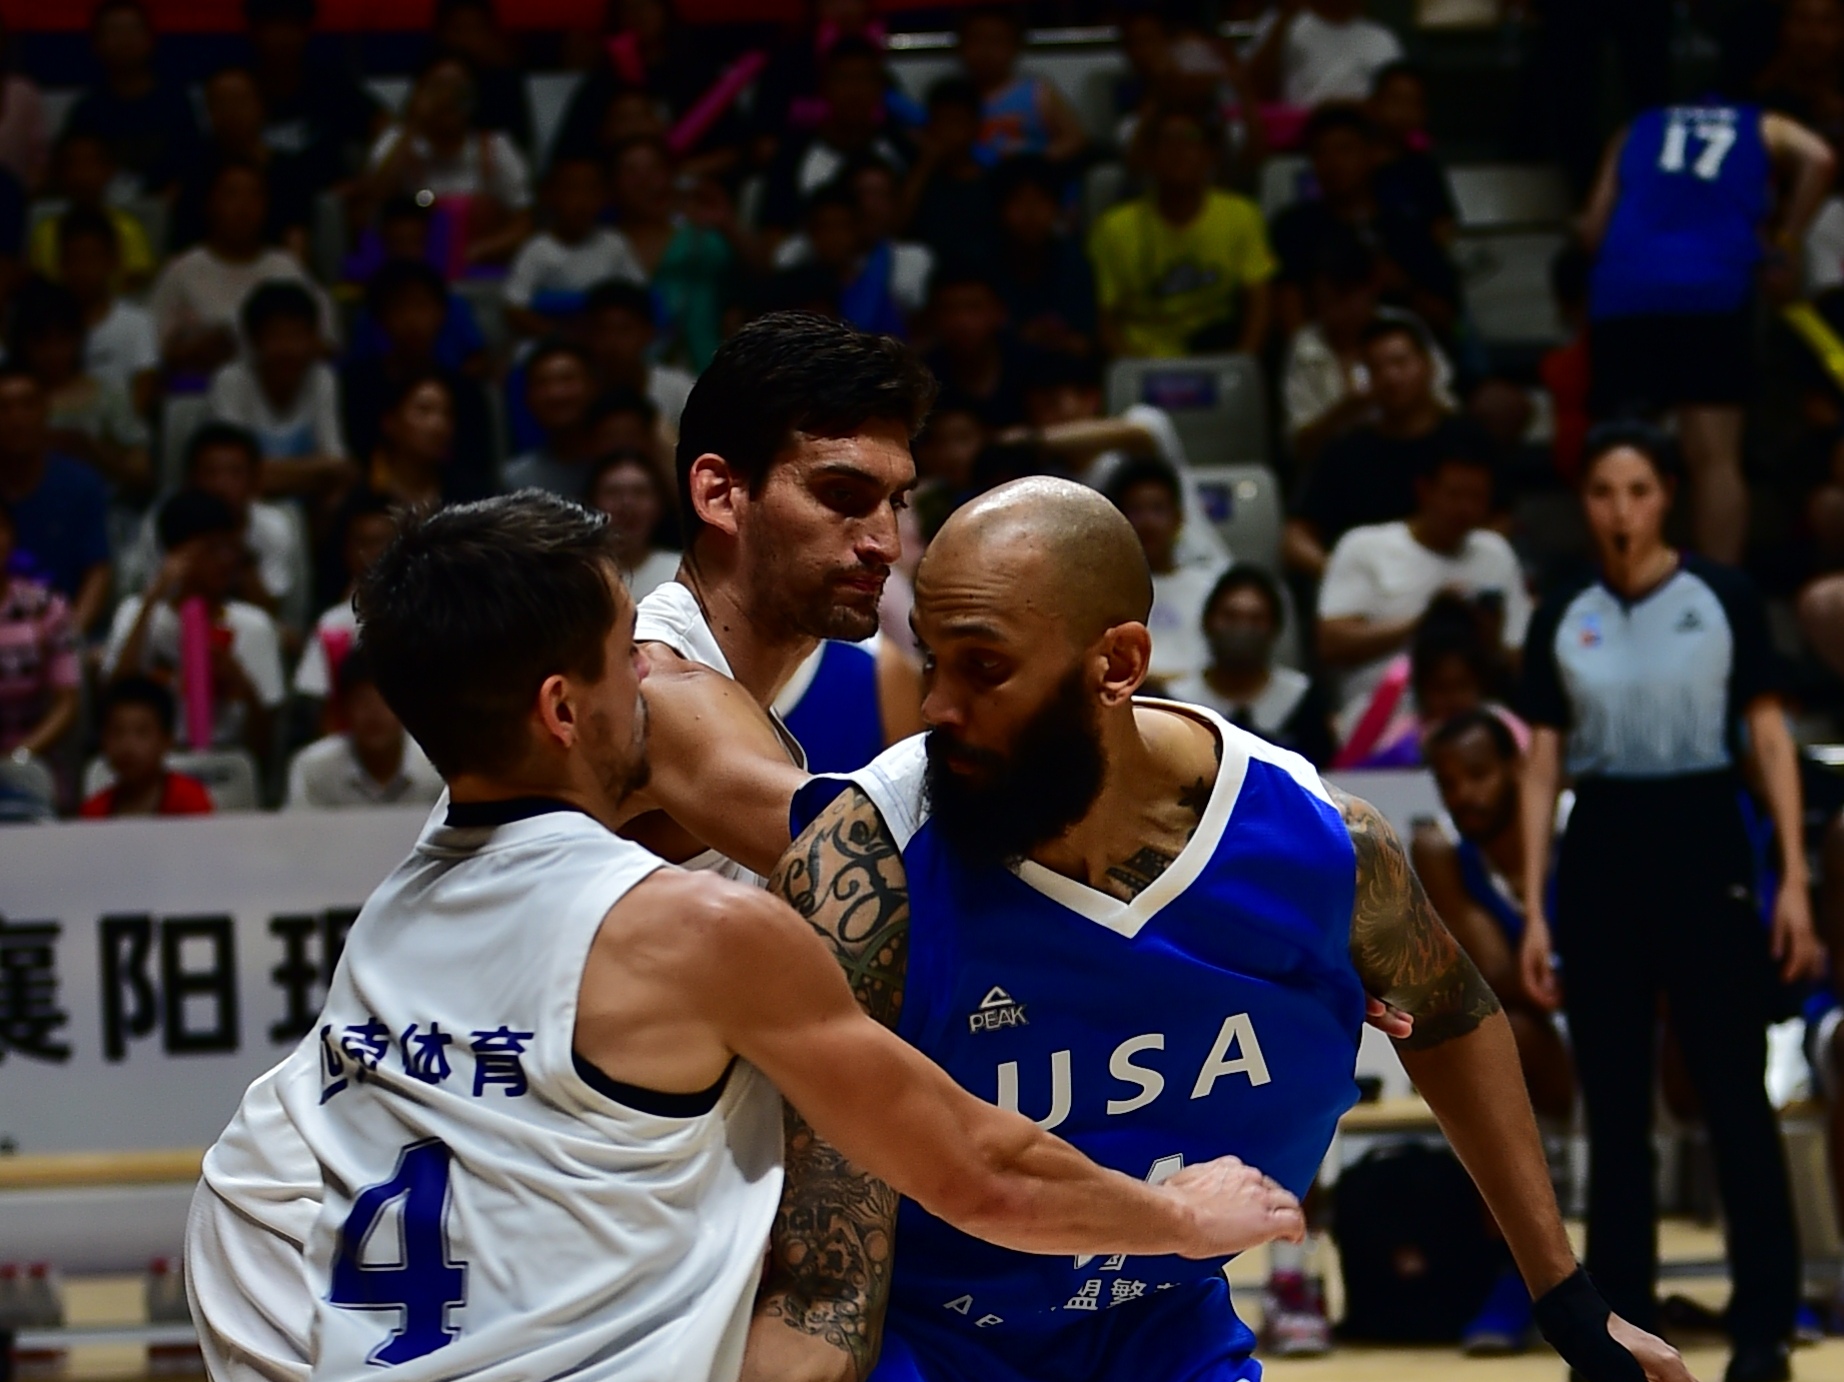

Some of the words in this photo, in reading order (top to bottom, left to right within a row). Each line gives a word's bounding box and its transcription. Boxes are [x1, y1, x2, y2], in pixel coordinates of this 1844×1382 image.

[1656, 121, 1738, 181] 17
[968, 1004, 1030, 1035] PEAK
[997, 1013, 1272, 1131] USA
[325, 1136, 469, 1367] 4
[1061, 1277, 1181, 1311] 盟繁
